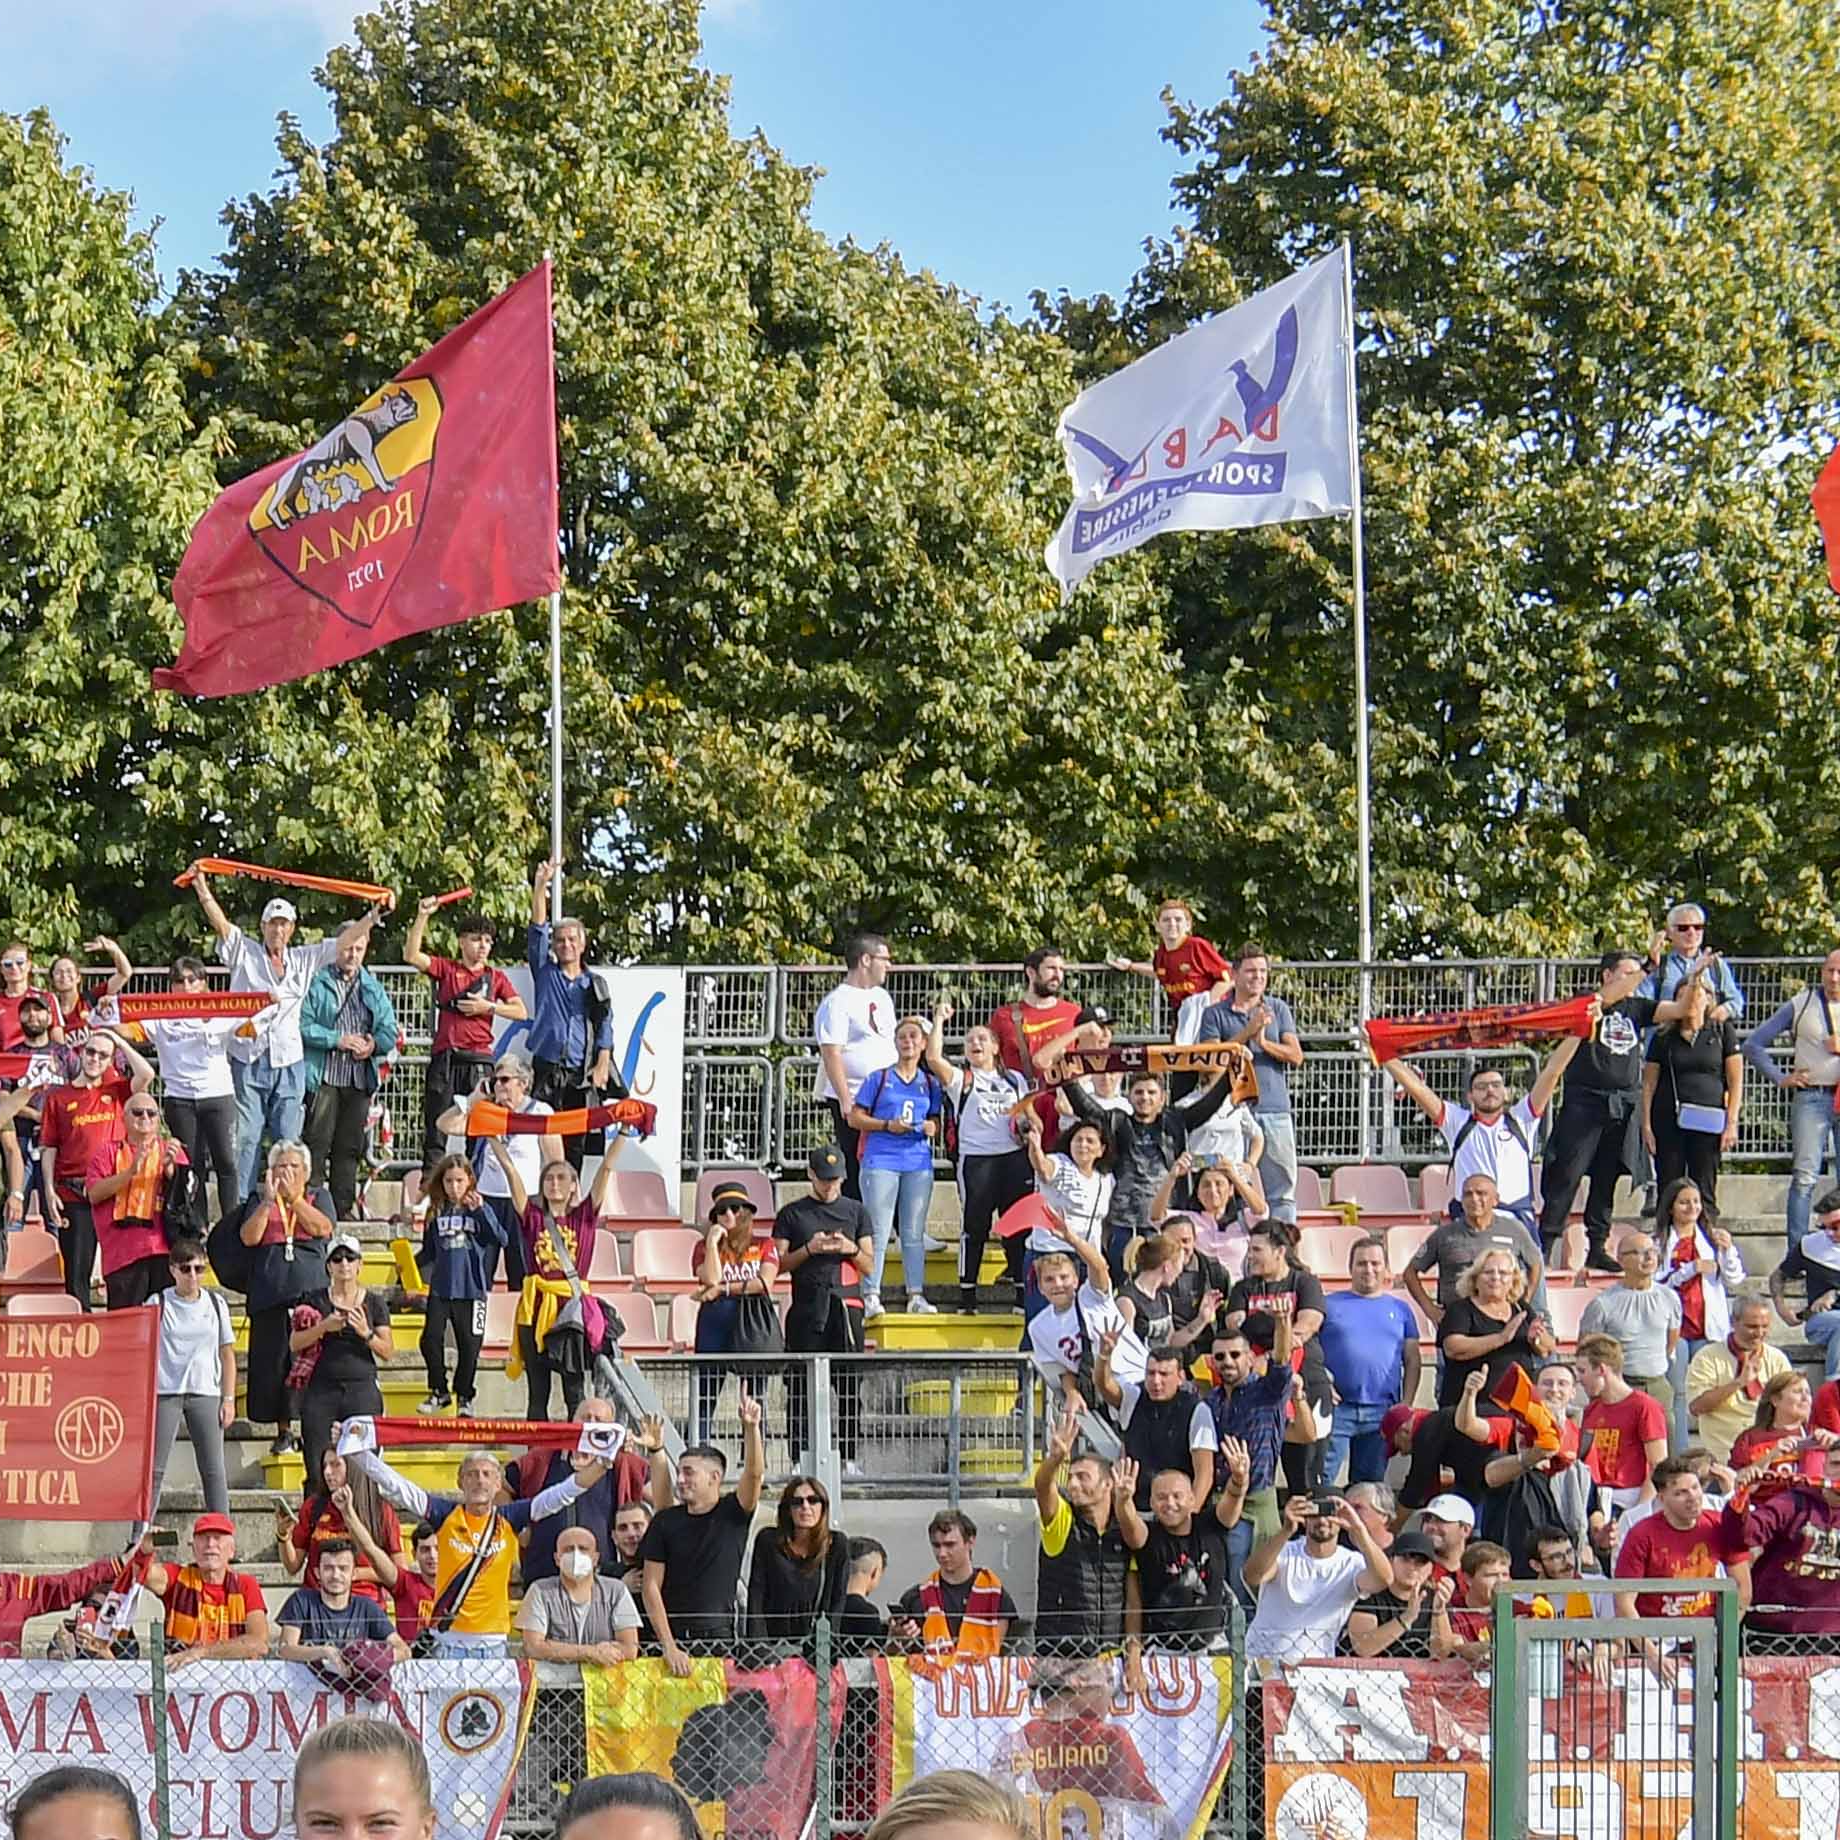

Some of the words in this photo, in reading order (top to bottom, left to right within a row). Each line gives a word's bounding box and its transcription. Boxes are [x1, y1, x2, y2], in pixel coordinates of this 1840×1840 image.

[122, 999, 148, 1014] NOI
[150, 998, 198, 1014] SIAMO
[901, 1098, 913, 1125] 6
[147, 1779, 288, 1840] CLU
